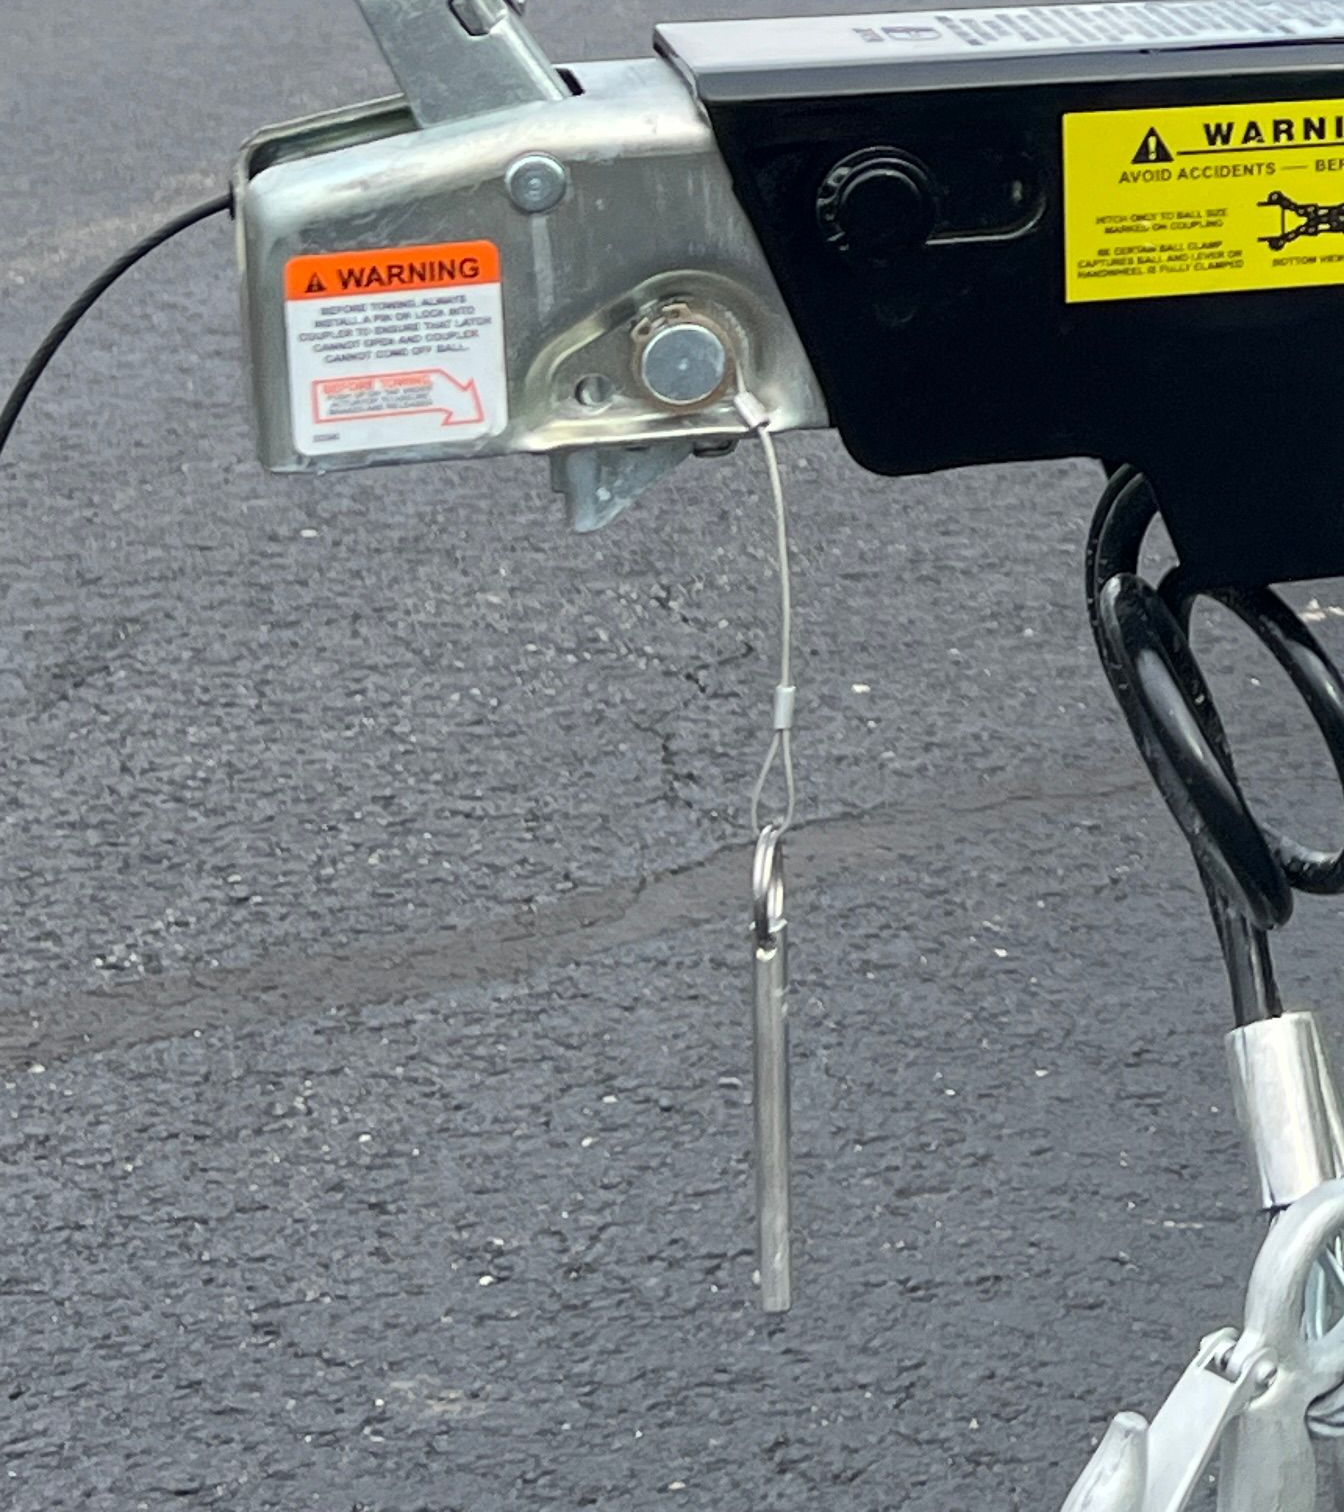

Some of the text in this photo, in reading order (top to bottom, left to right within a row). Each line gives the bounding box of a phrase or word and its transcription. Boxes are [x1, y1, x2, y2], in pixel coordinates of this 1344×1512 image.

[1119, 168, 1171, 184] AVOID
[1177, 162, 1276, 181] ACCIDENTS
[338, 258, 480, 290] WARNING
